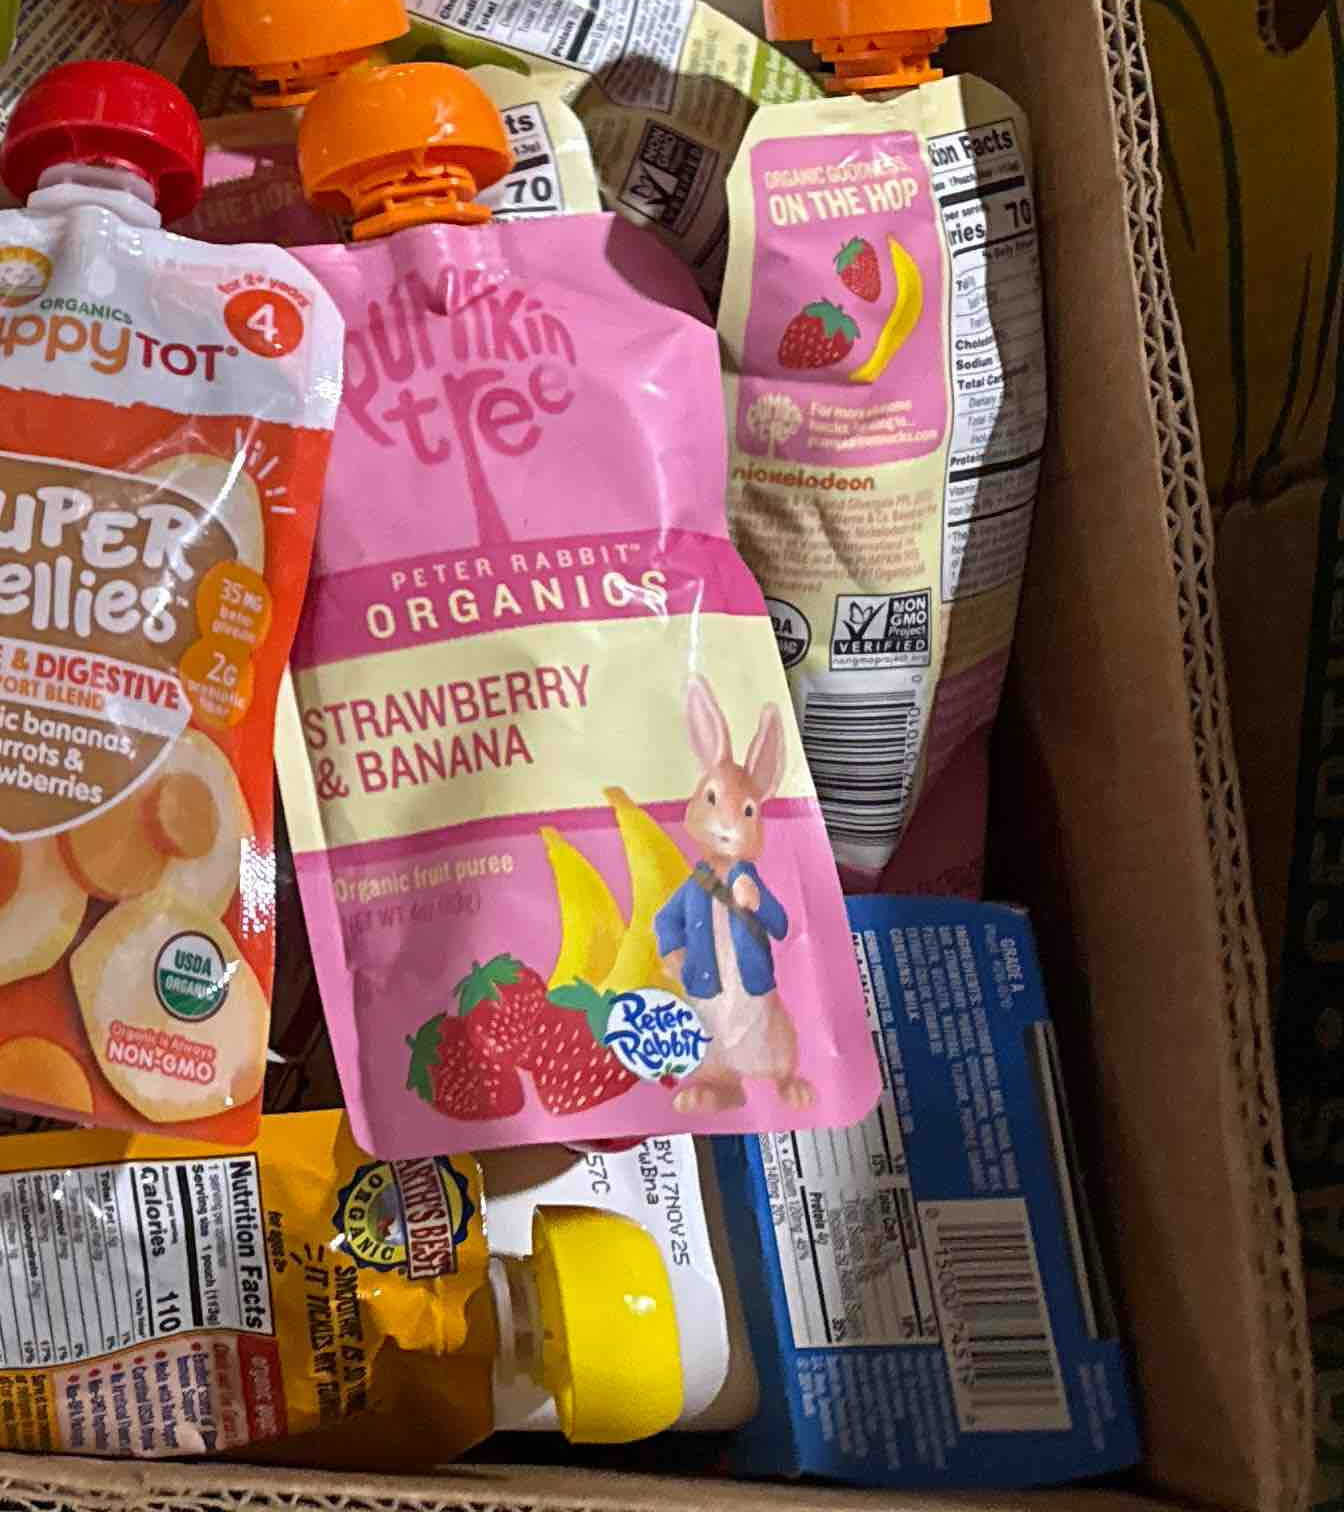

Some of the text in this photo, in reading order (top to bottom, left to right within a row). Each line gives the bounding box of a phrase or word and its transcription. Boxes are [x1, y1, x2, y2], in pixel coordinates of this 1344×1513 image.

[768, 178, 919, 226] ON THE HOP
[40, 298, 133, 324] ORGANICS
[247, 304, 277, 342] 4
[384, 364, 576, 466] tree
[391, 563, 494, 591] PETER
[367, 569, 668, 639] ORGANICS
[838, 640, 926, 653] VERIFIED
[35, 654, 181, 709] DIGESTIVE
[306, 664, 591, 750] STRAWBERRY
[23, 712, 137, 759] bananas,
[355, 725, 534, 794] BANANA
[623, 994, 692, 1034] Peter
[108, 1043, 213, 1081] NON-GMO
[605, 1030, 712, 1071] Rabbit
[660, 1171, 691, 1266] 17NOV25
[230, 1160, 264, 1329] Nutrition Facts
[156, 1289, 180, 1333] 110
